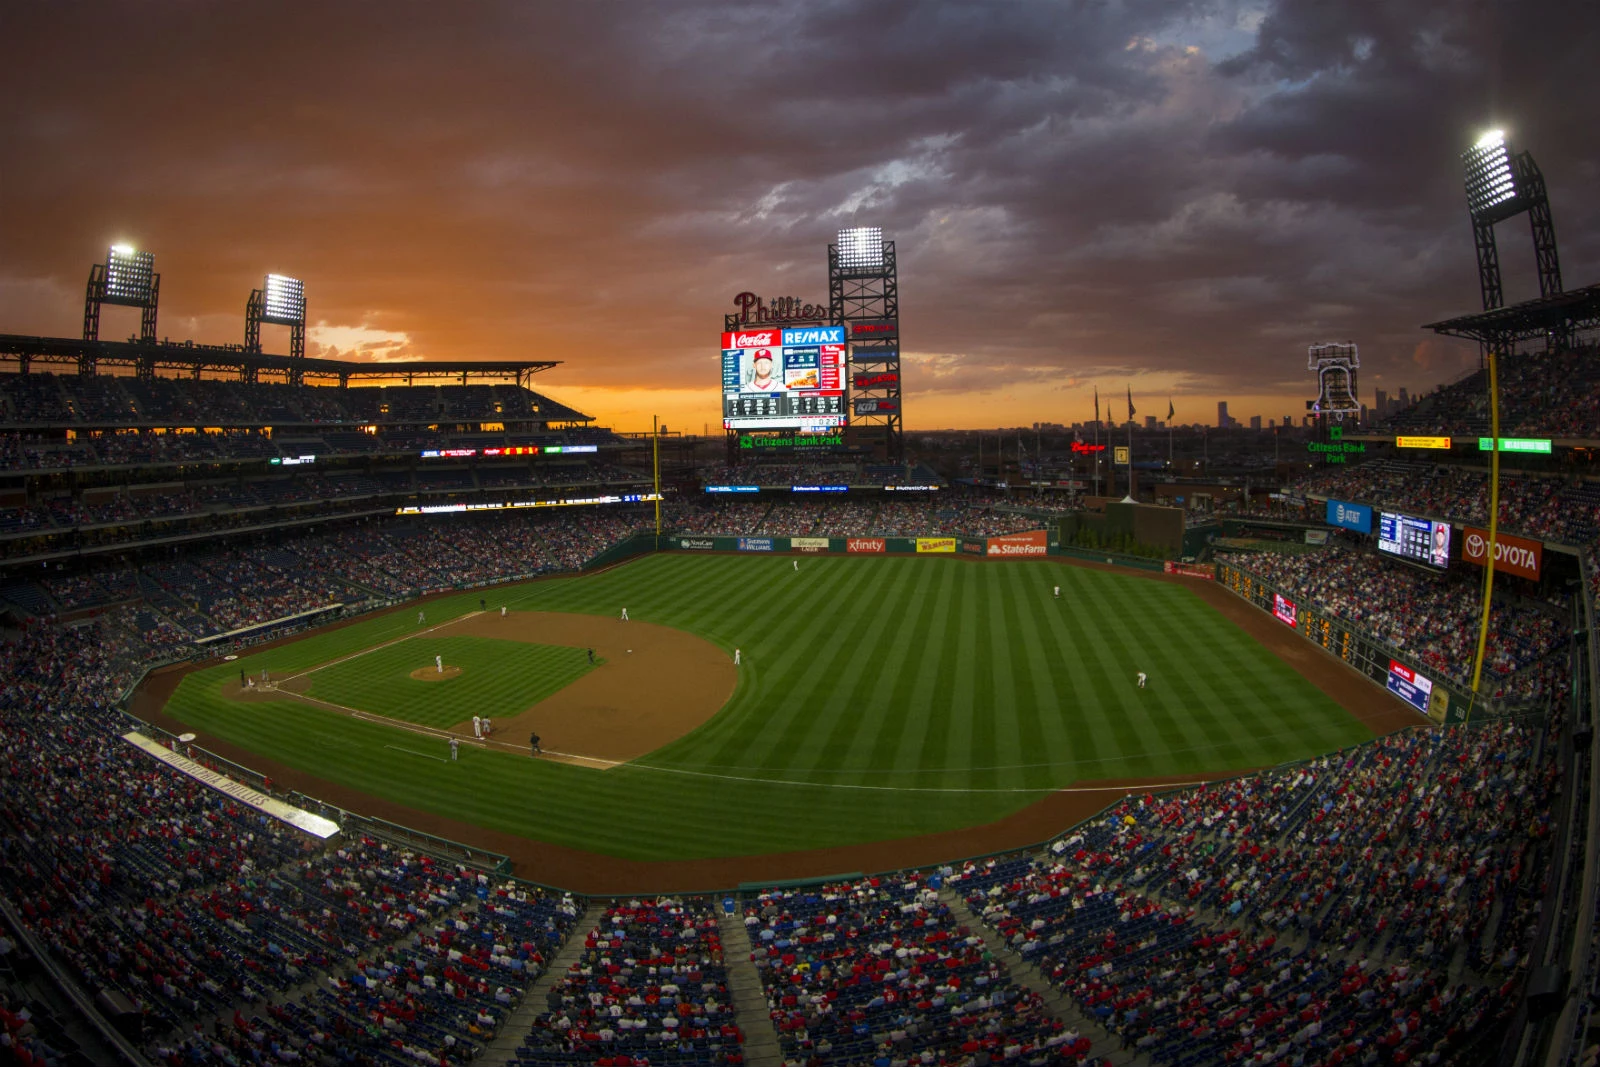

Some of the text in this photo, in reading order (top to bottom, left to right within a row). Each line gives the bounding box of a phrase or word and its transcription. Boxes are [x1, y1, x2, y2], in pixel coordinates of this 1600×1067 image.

[735, 292, 827, 322] Phillies
[737, 333, 773, 346] Coca-Cola
[785, 330, 840, 344] RE/MAX
[754, 435, 842, 447] Citizens Bank Park
[1308, 442, 1365, 452] Citizens Bank
[1326, 453, 1345, 463] Park
[1345, 510, 1360, 524] AT&T
[849, 539, 883, 552] xfinity
[1485, 541, 1536, 571] TOYOTA
[162, 753, 269, 805] PHILADELPHIA PHILLIES
